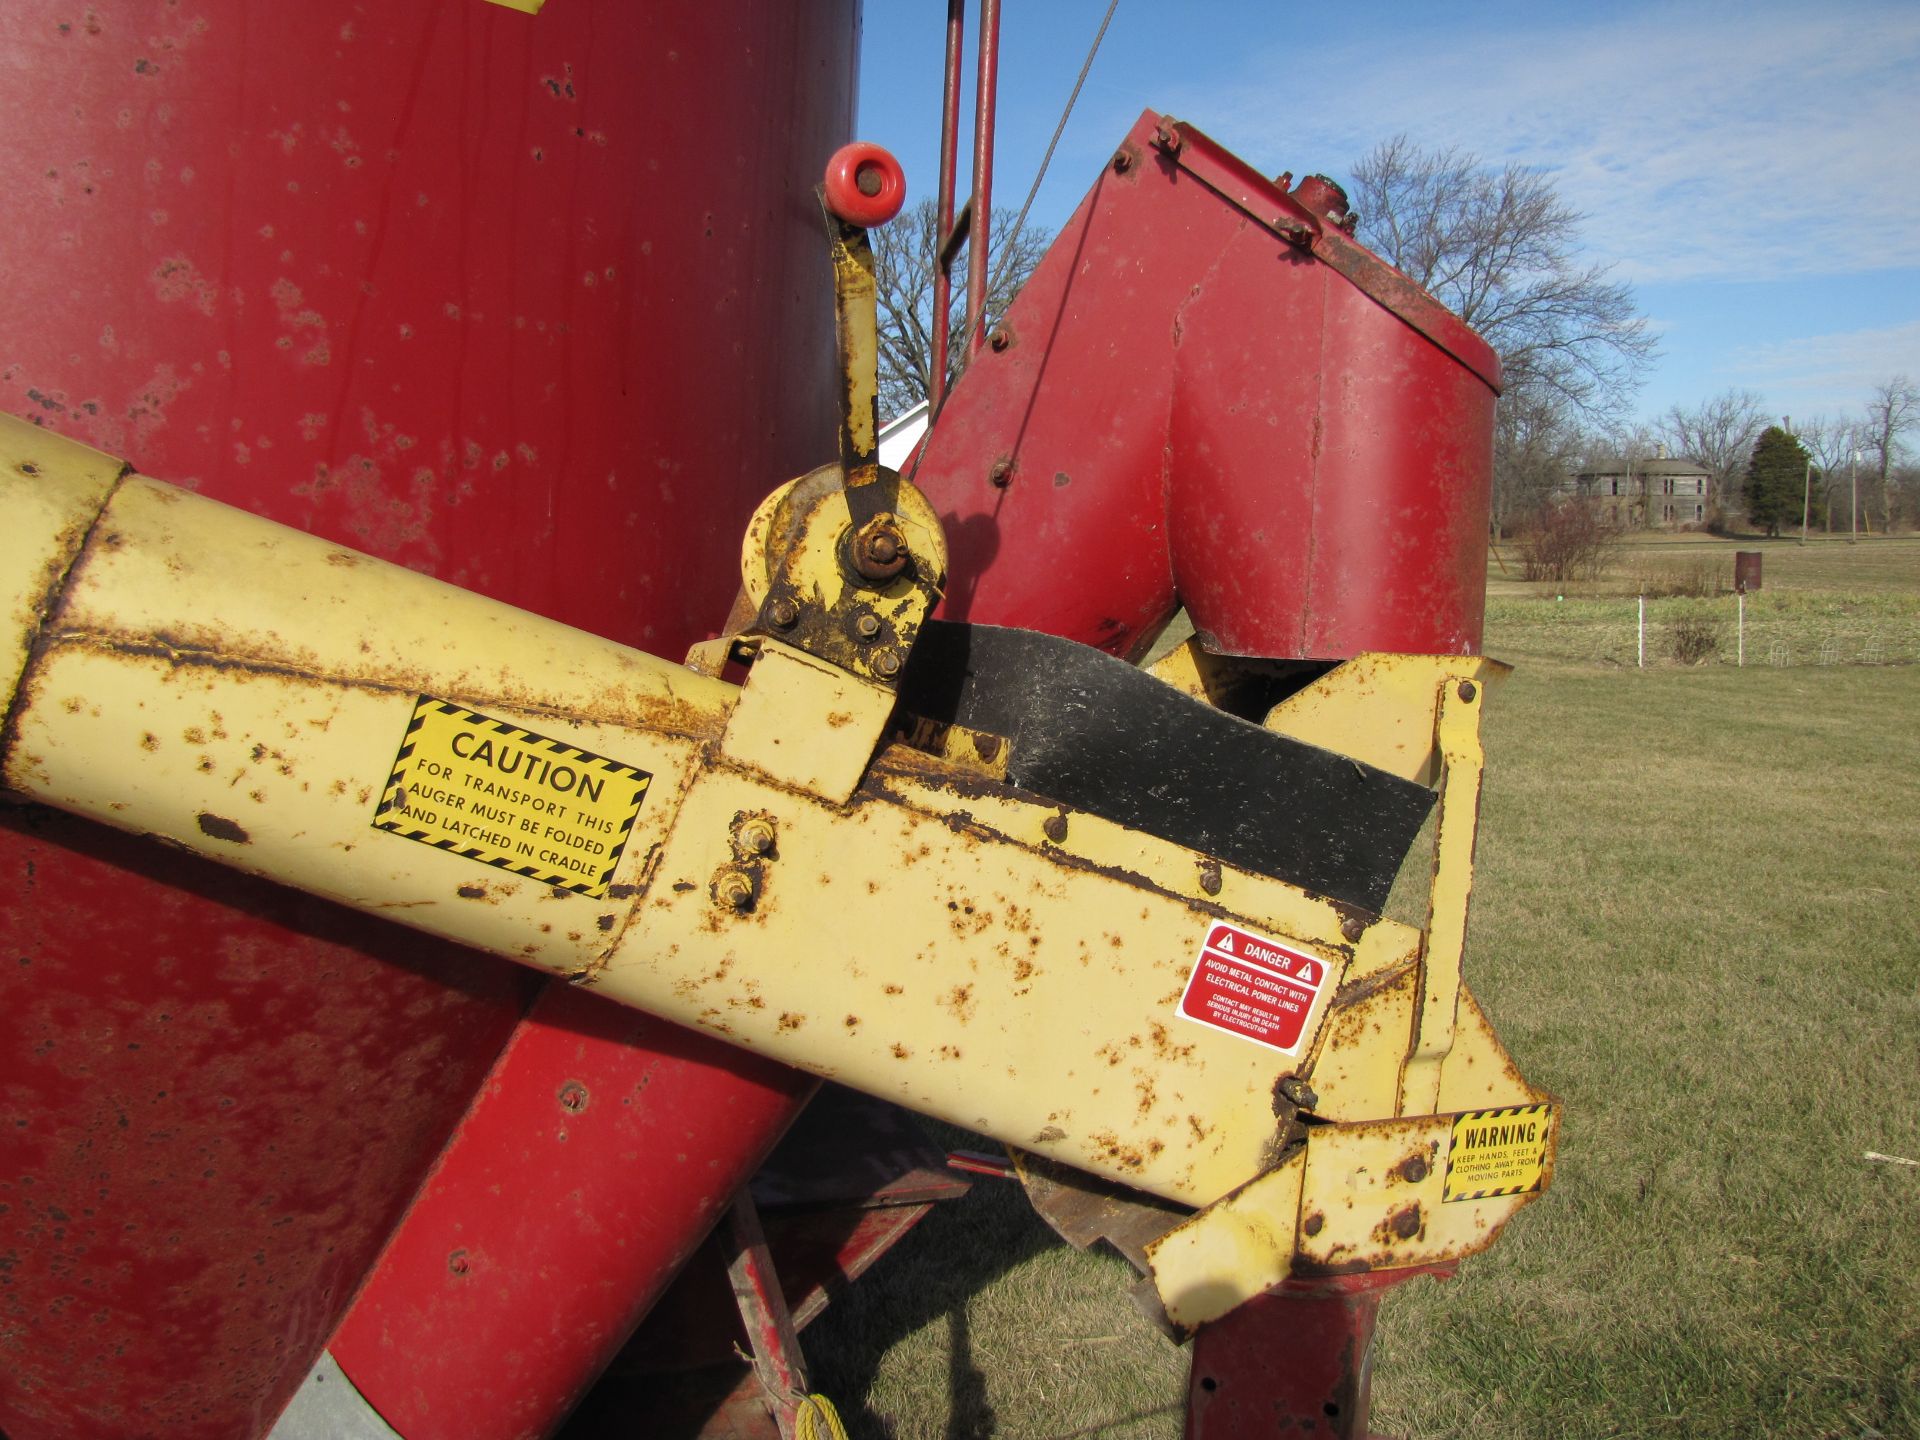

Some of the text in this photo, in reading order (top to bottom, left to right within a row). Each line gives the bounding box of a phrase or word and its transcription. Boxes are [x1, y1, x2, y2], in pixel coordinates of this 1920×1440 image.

[451, 732, 605, 803] CAUTION
[417, 758, 614, 834] FOR TRANSPORT THIS
[409, 782, 604, 855] AUGER MUST BE FOLDED
[400, 804, 597, 877] AND LATCHED IN CRADLE
[1244, 943, 1290, 969] DANGER
[1205, 959, 1308, 1002] AVOID METAL CONTACT WITH
[1206, 973, 1299, 1013] ELECTRICAL POWER LINES
[1207, 1001, 1231, 1014] SERIOUS
[1232, 1009, 1251, 1020] INJURY
[1261, 1019, 1279, 1030] DEATH
[1213, 994, 1238, 1007] CONTACT
[1239, 1003, 1251, 1012] MAY
[1252, 1007, 1272, 1019] RESULT
[1222, 1015, 1268, 1034] ELECTROCUTION
[1465, 1122, 1536, 1149] WARNING
[1456, 1158, 1536, 1173] CLOTHING AWAY FROM
[1457, 1155, 1475, 1163] KEEP
[1513, 1148, 1529, 1157] FEET
[1467, 1169, 1523, 1182] MOVING PARTS
